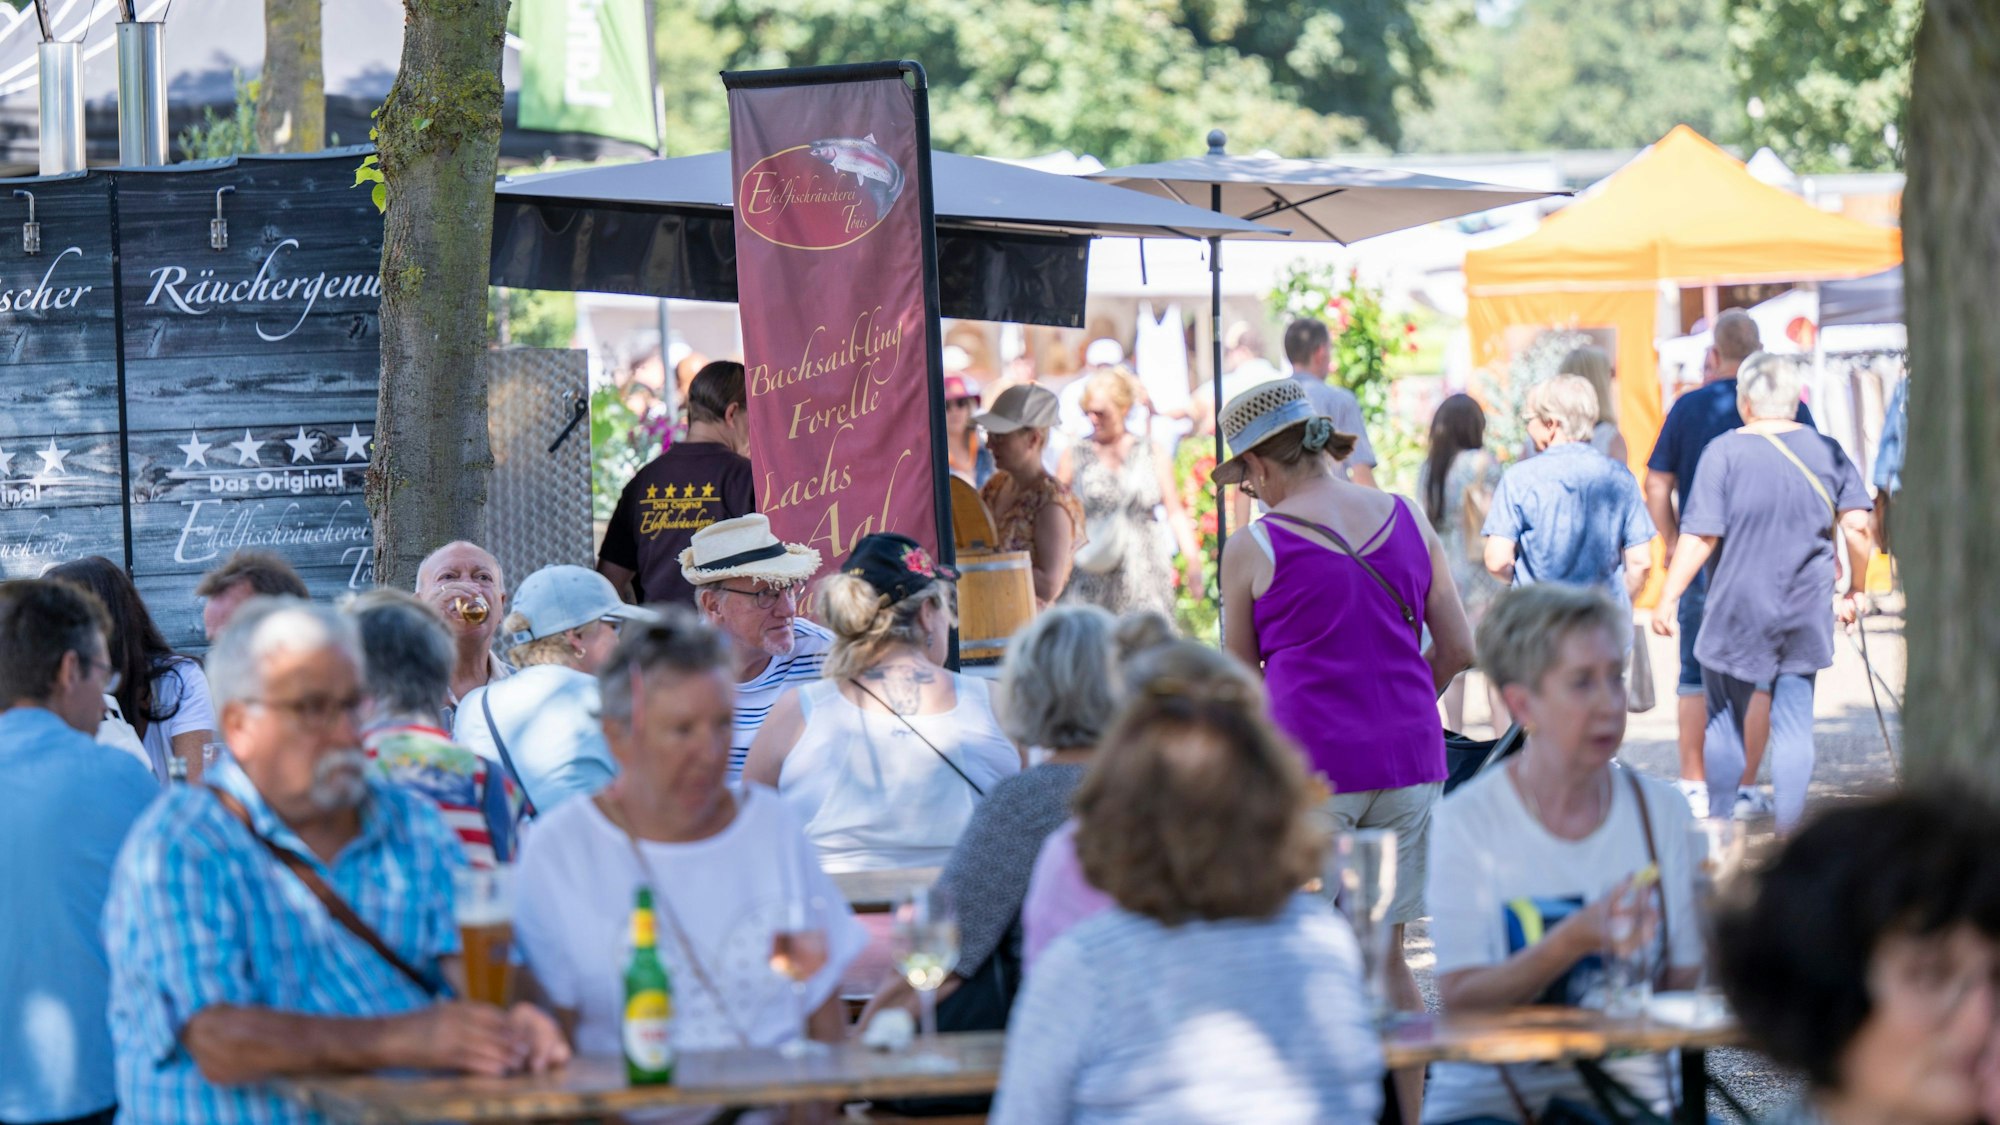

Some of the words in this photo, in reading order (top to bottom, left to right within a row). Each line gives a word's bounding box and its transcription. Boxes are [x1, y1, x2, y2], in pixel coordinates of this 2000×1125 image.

[747, 171, 859, 225] Edelfischräucherei
[0, 246, 92, 312] scher
[144, 238, 382, 342] Räuchergenu
[748, 305, 903, 398] Bachsaibling
[788, 357, 882, 440] Forelle
[0, 481, 42, 503] inal
[210, 475, 249, 493] Das
[256, 468, 344, 494] Original
[762, 423, 854, 514] Lachs
[173, 498, 372, 564] Edelfischräucherei
